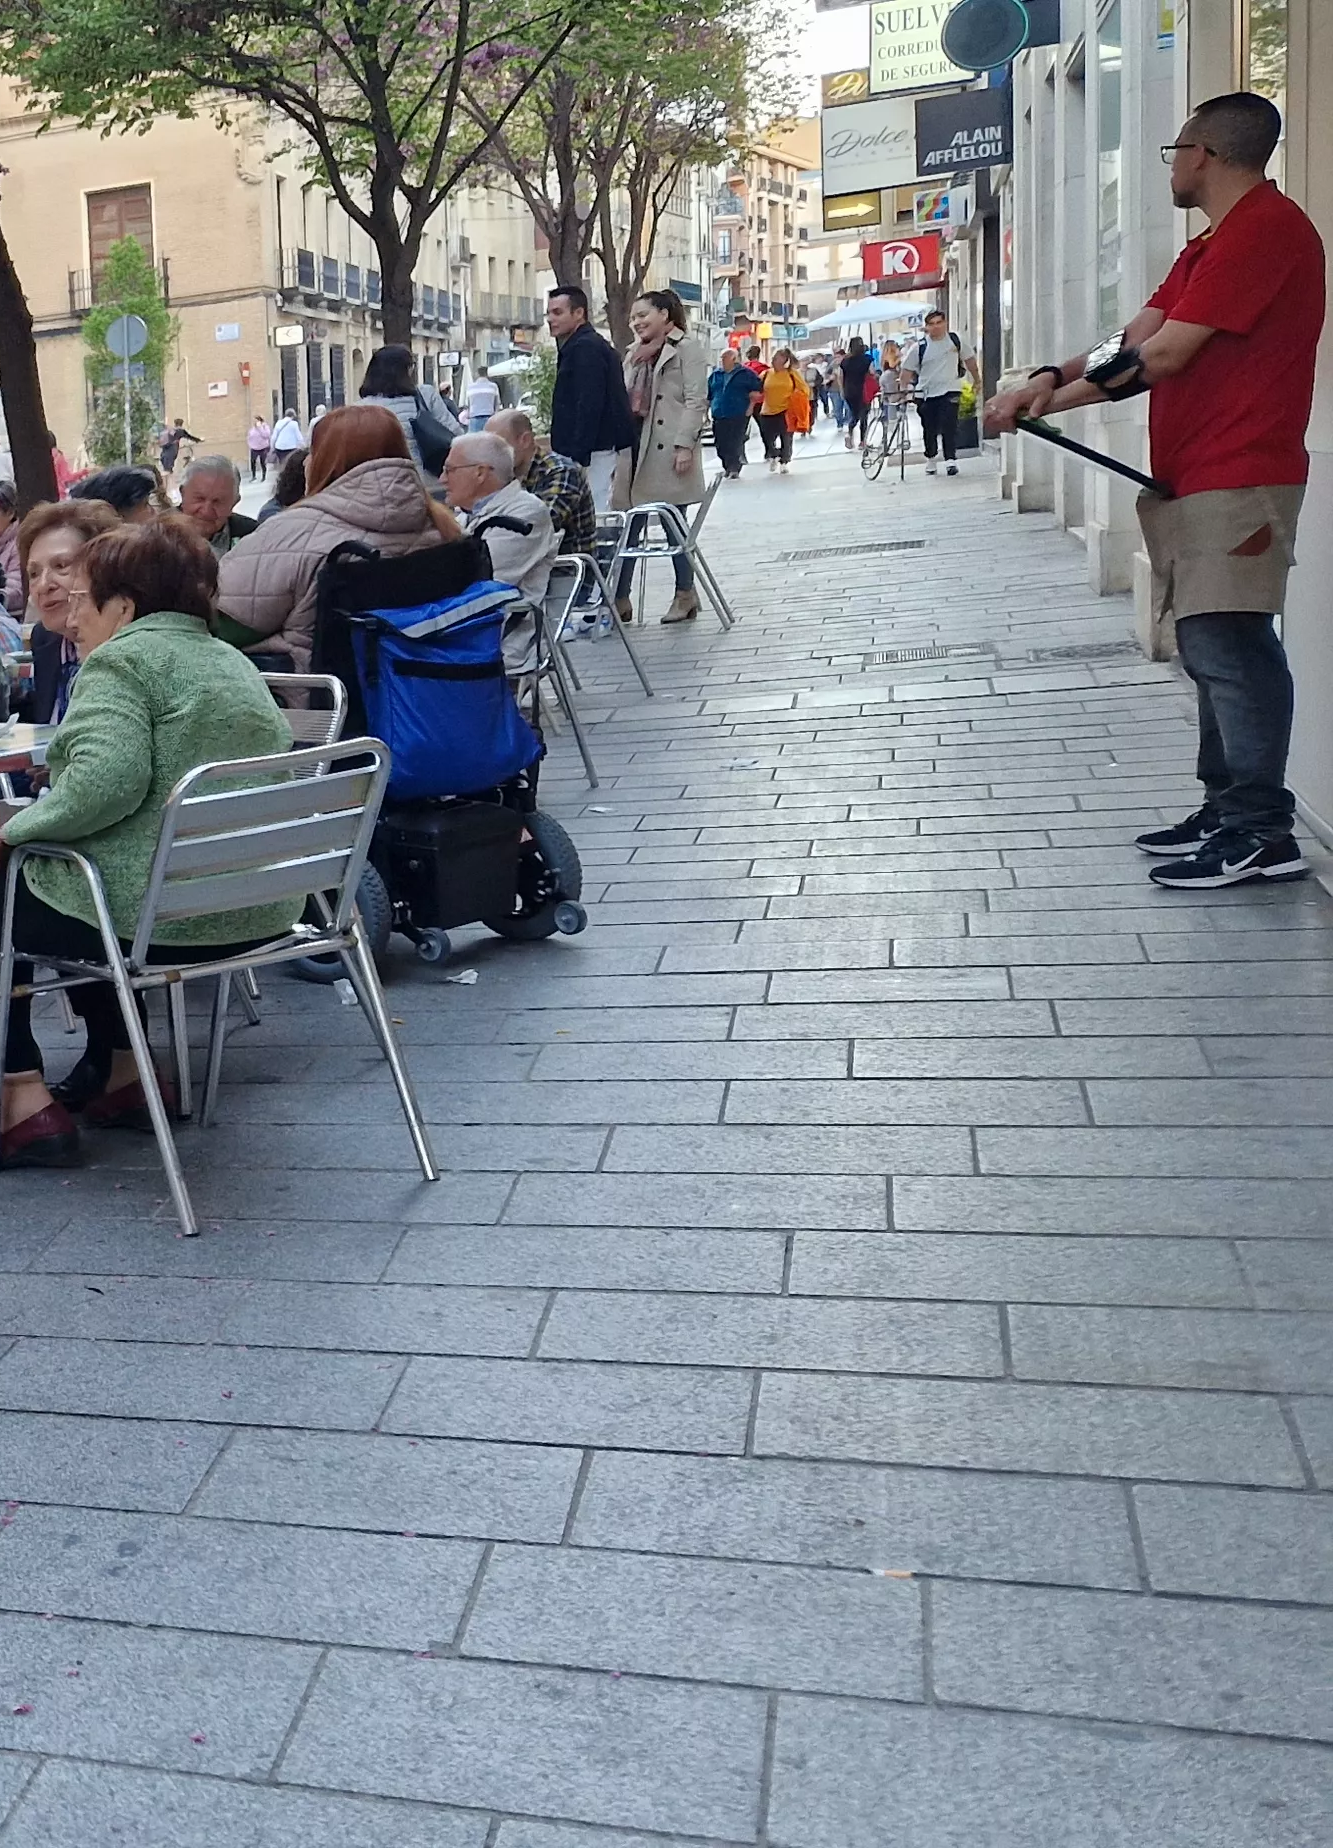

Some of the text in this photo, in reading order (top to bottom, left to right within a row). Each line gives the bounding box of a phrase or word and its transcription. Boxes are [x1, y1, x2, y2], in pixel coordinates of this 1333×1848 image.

[875, 2, 953, 36] SUELV
[880, 68, 899, 82] DE
[949, 125, 1002, 147] ALAIN
[922, 141, 1003, 168] AFFLELOU
